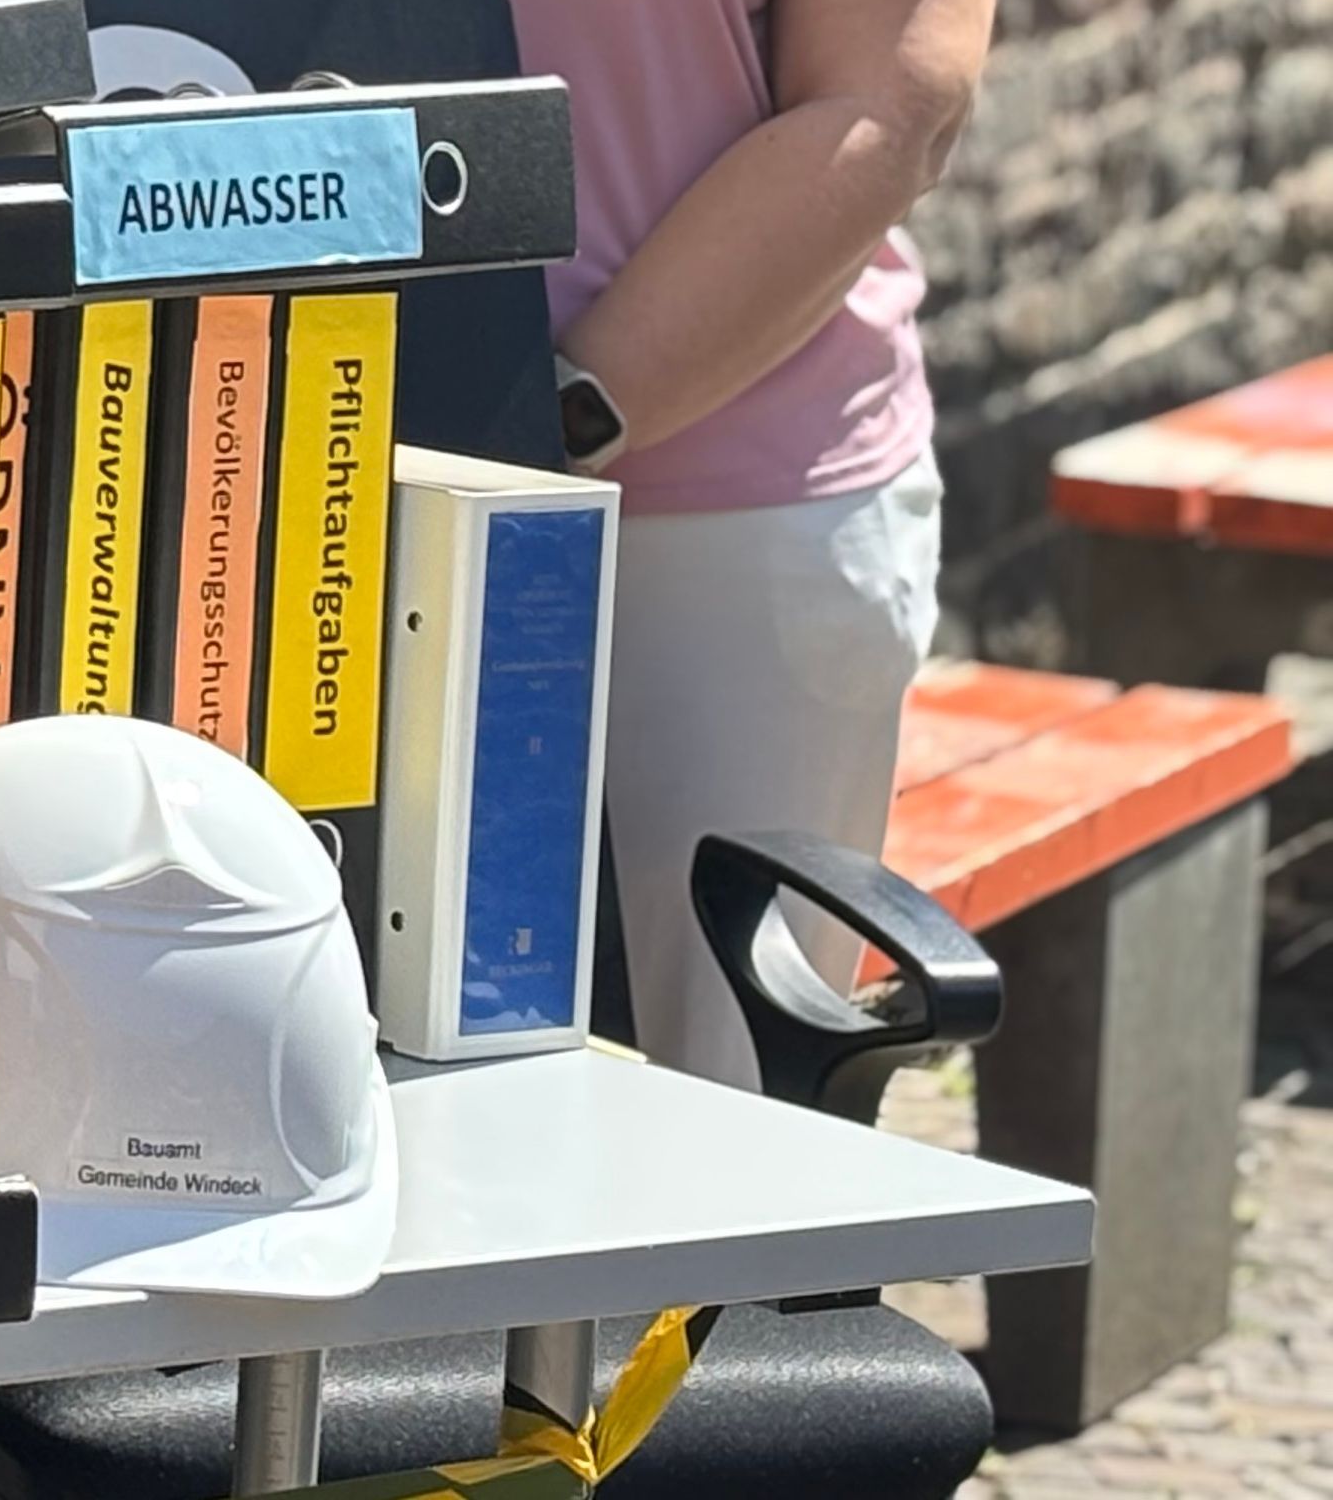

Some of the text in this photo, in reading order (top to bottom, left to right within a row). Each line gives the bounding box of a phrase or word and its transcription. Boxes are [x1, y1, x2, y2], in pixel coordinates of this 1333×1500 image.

[117, 171, 348, 237] ABWASSER
[312, 358, 364, 739] Pflichtaufgaben
[127, 1137, 202, 1160] Bauamt
[77, 1164, 263, 1196] Gemeinde Windeck
